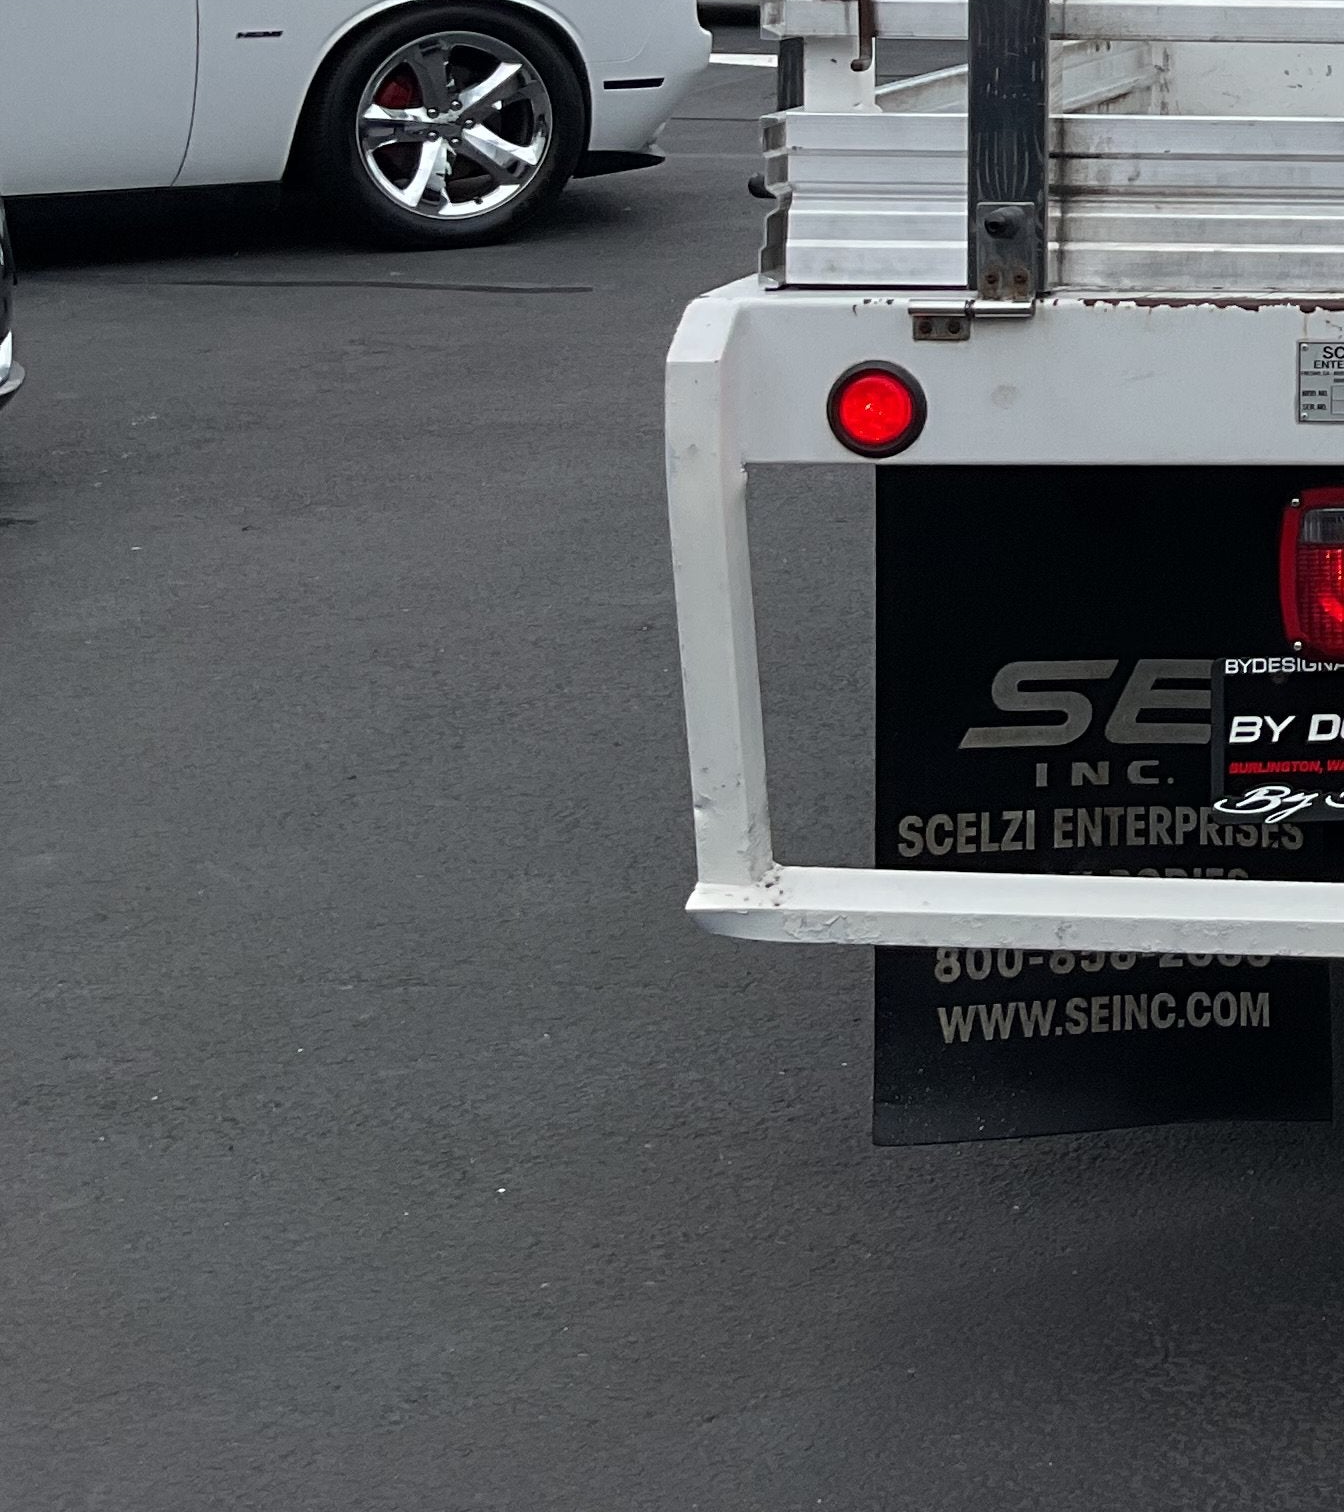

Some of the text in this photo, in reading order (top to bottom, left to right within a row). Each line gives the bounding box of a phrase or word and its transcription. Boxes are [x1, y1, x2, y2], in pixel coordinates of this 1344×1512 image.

[958, 658, 1212, 750] SE
[1228, 715, 1296, 744] BY
[1036, 760, 1174, 787] INC.
[1228, 760, 1323, 775] BURLINGTON,
[1213, 785, 1319, 824] By
[898, 809, 1035, 857] SCELZI
[937, 991, 1270, 1043] WWW.SEINC.COM
